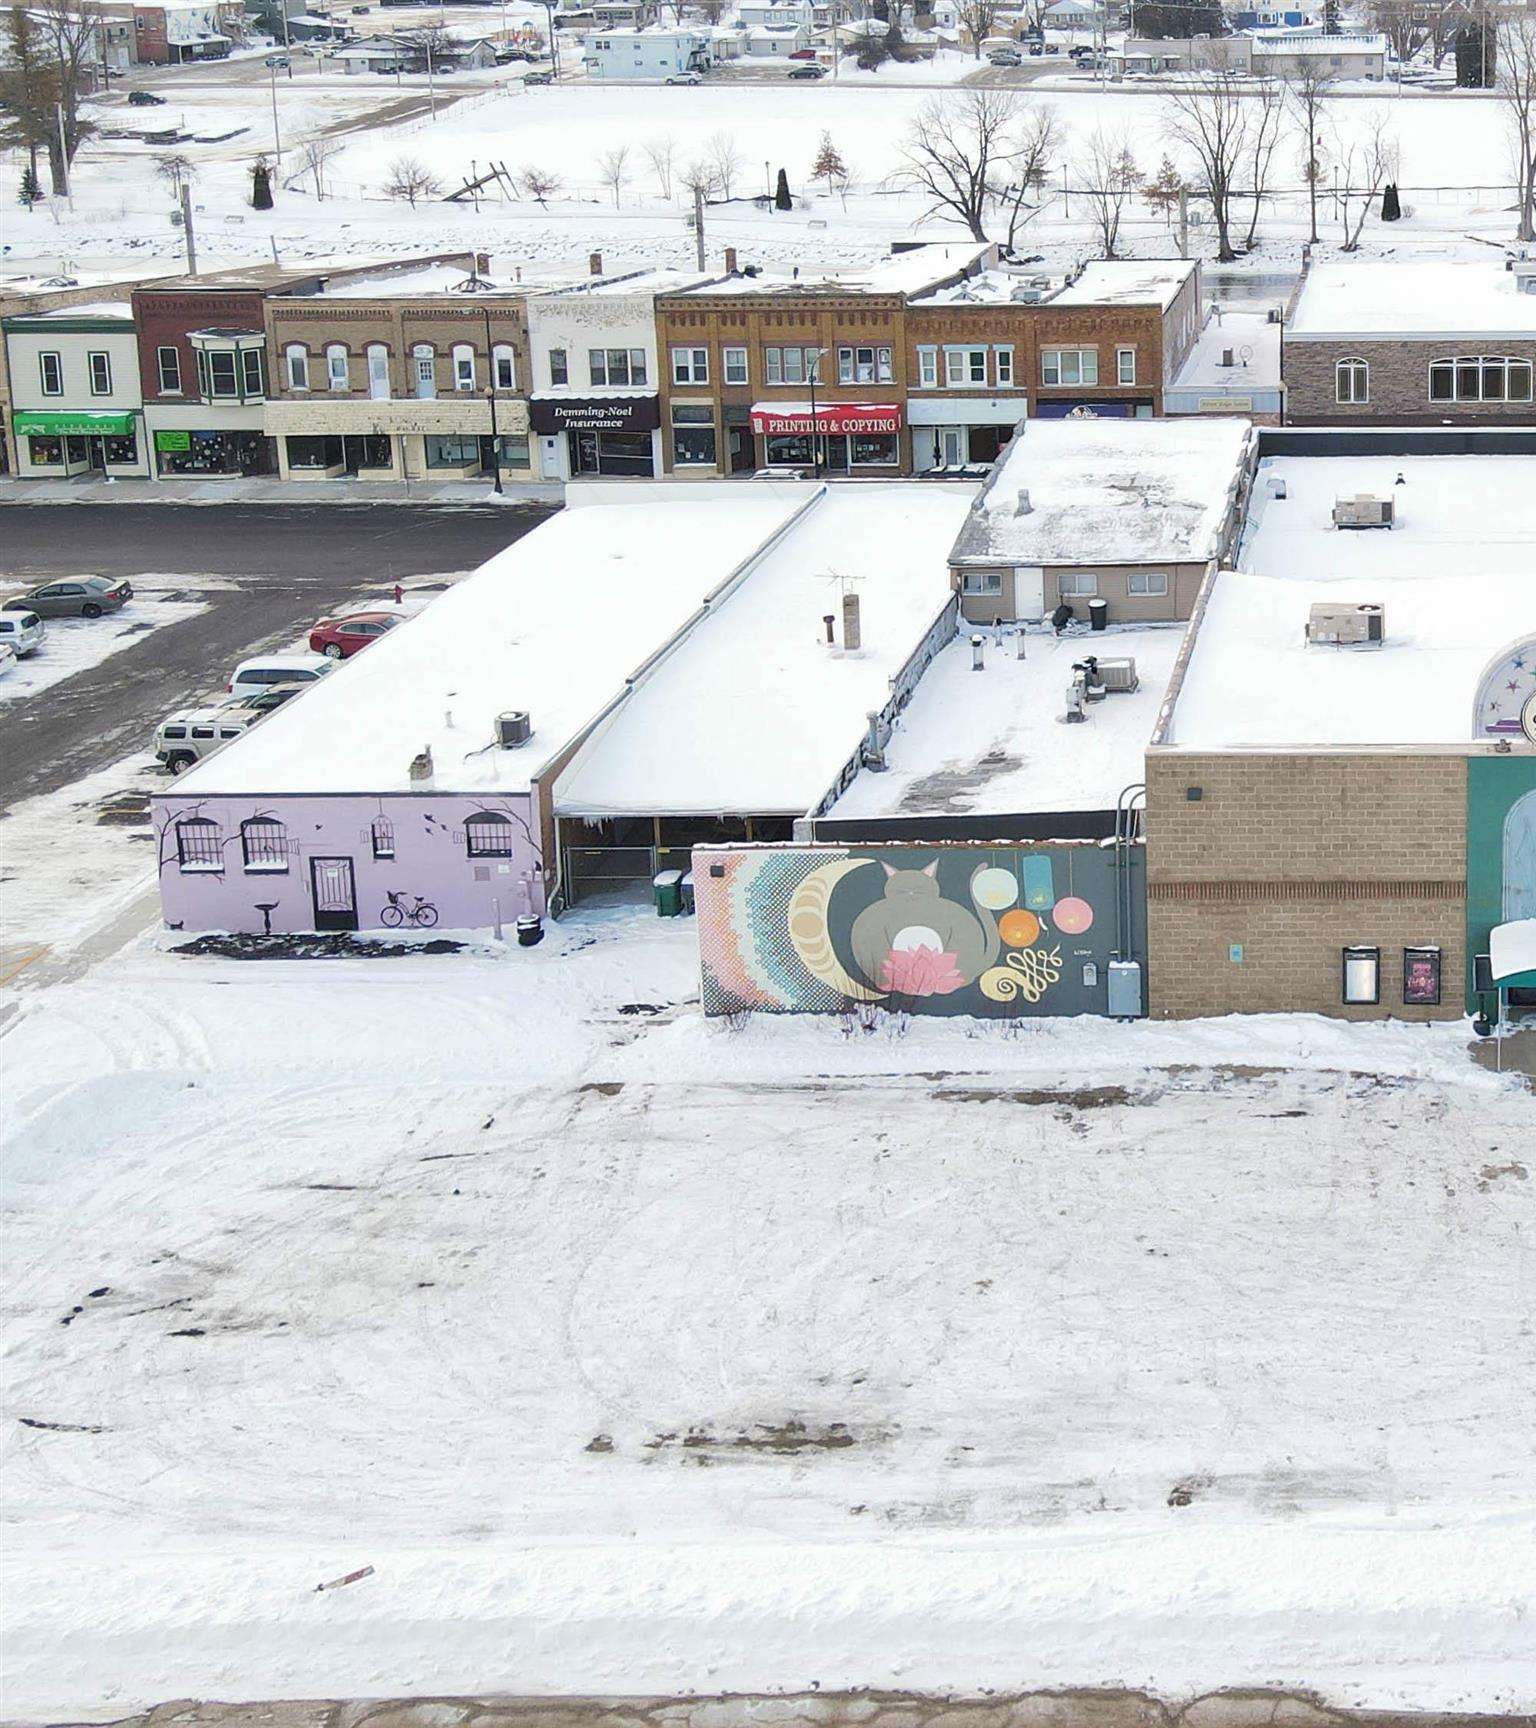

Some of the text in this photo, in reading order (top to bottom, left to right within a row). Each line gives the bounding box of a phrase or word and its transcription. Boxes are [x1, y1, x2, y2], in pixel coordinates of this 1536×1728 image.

[554, 406, 632, 418] Demming-Noel
[565, 419, 623, 428] Insurance
[769, 419, 827, 432] PRINTING
[829, 419, 839, 431] &
[842, 419, 896, 431] COPYING
